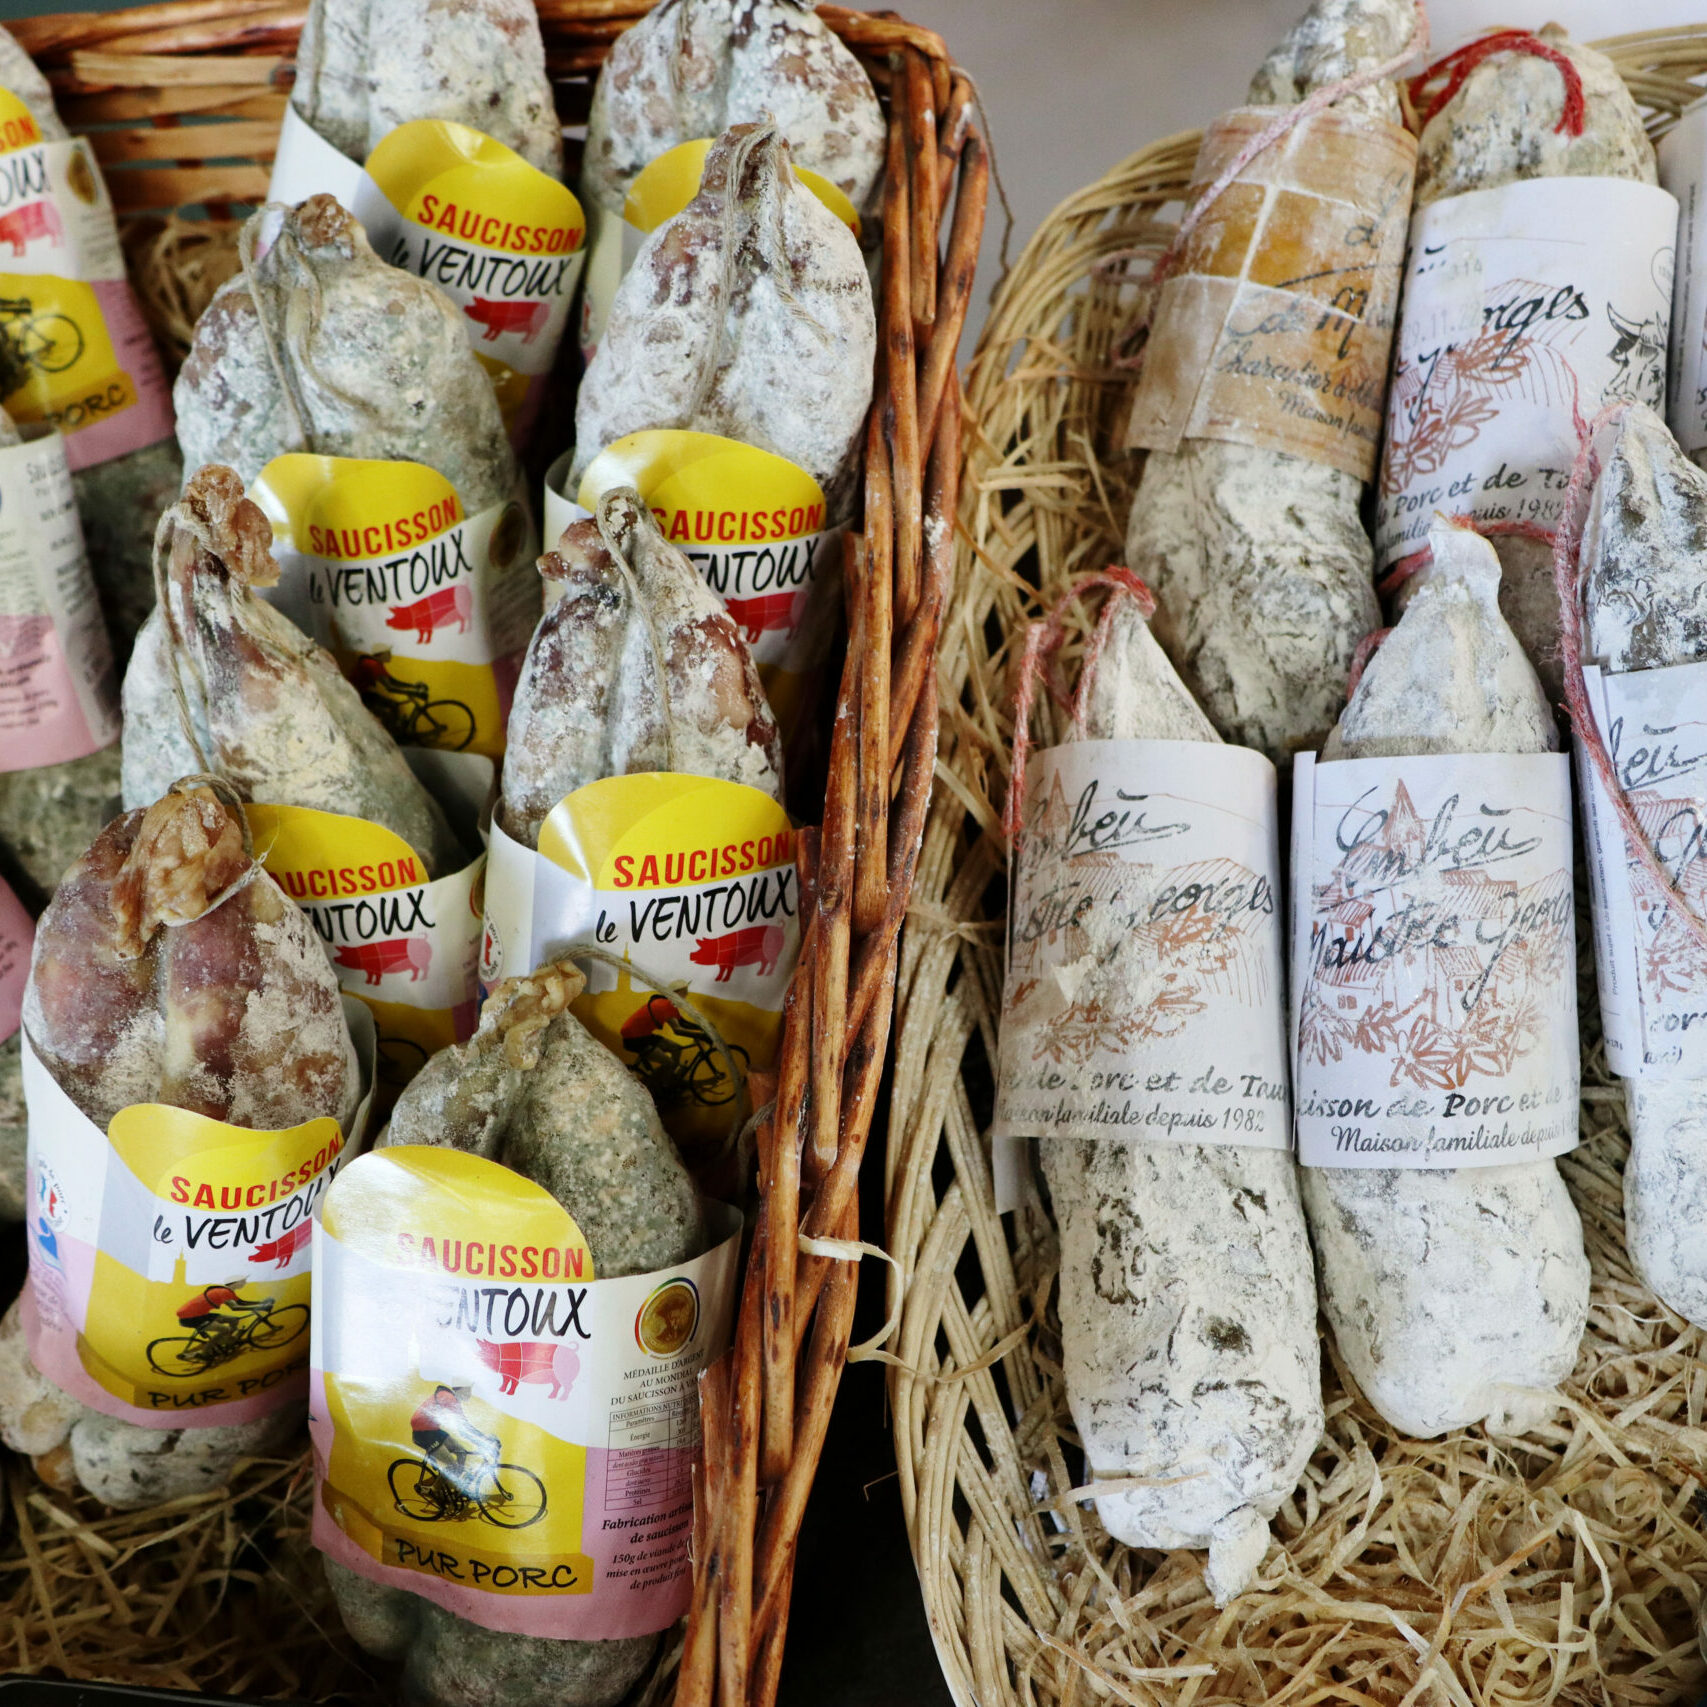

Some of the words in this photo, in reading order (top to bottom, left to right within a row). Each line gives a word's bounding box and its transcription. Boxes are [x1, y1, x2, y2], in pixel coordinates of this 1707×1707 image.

[417, 194, 584, 254] SAUCISSON
[418, 238, 572, 297] VENTOUX
[1393, 485, 1443, 518] Porc
[1447, 472, 1477, 499] et
[1482, 463, 1528, 492] de
[309, 495, 457, 559] SAUCISSON
[325, 528, 473, 608] VENTOUX
[613, 831, 790, 888] SAUCISSON
[595, 909, 618, 944] le
[630, 868, 796, 943] VENTOUX
[1146, 1071, 1182, 1092] et
[1189, 1065, 1233, 1096] de
[1145, 1102, 1217, 1136] depuis
[1222, 1107, 1265, 1133] 1982
[1442, 1093, 1515, 1118] Porc
[1331, 1124, 1422, 1152] Maison
[1422, 1124, 1518, 1162] familiale
[171, 1132, 341, 1210] SAUCISSON
[153, 1214, 174, 1244] le
[398, 1232, 584, 1279] SAUCISSON
[148, 1384, 232, 1408] PUR
[611, 1396, 626, 1407] DU
[627, 1384, 677, 1403] SAUCISSON
[640, 1378, 653, 1388] AU
[602, 1513, 666, 1530] Fabrication
[630, 1533, 644, 1544] de
[646, 1520, 689, 1542] saucisson
[395, 1537, 467, 1580] PUR
[469, 1559, 578, 1590] PORC
[606, 1569, 629, 1579] mise
[630, 1567, 641, 1575] en
[613, 1553, 636, 1565] 150g
[637, 1551, 648, 1561] de
[629, 1579, 641, 1590] de
[642, 1573, 674, 1592] produit
